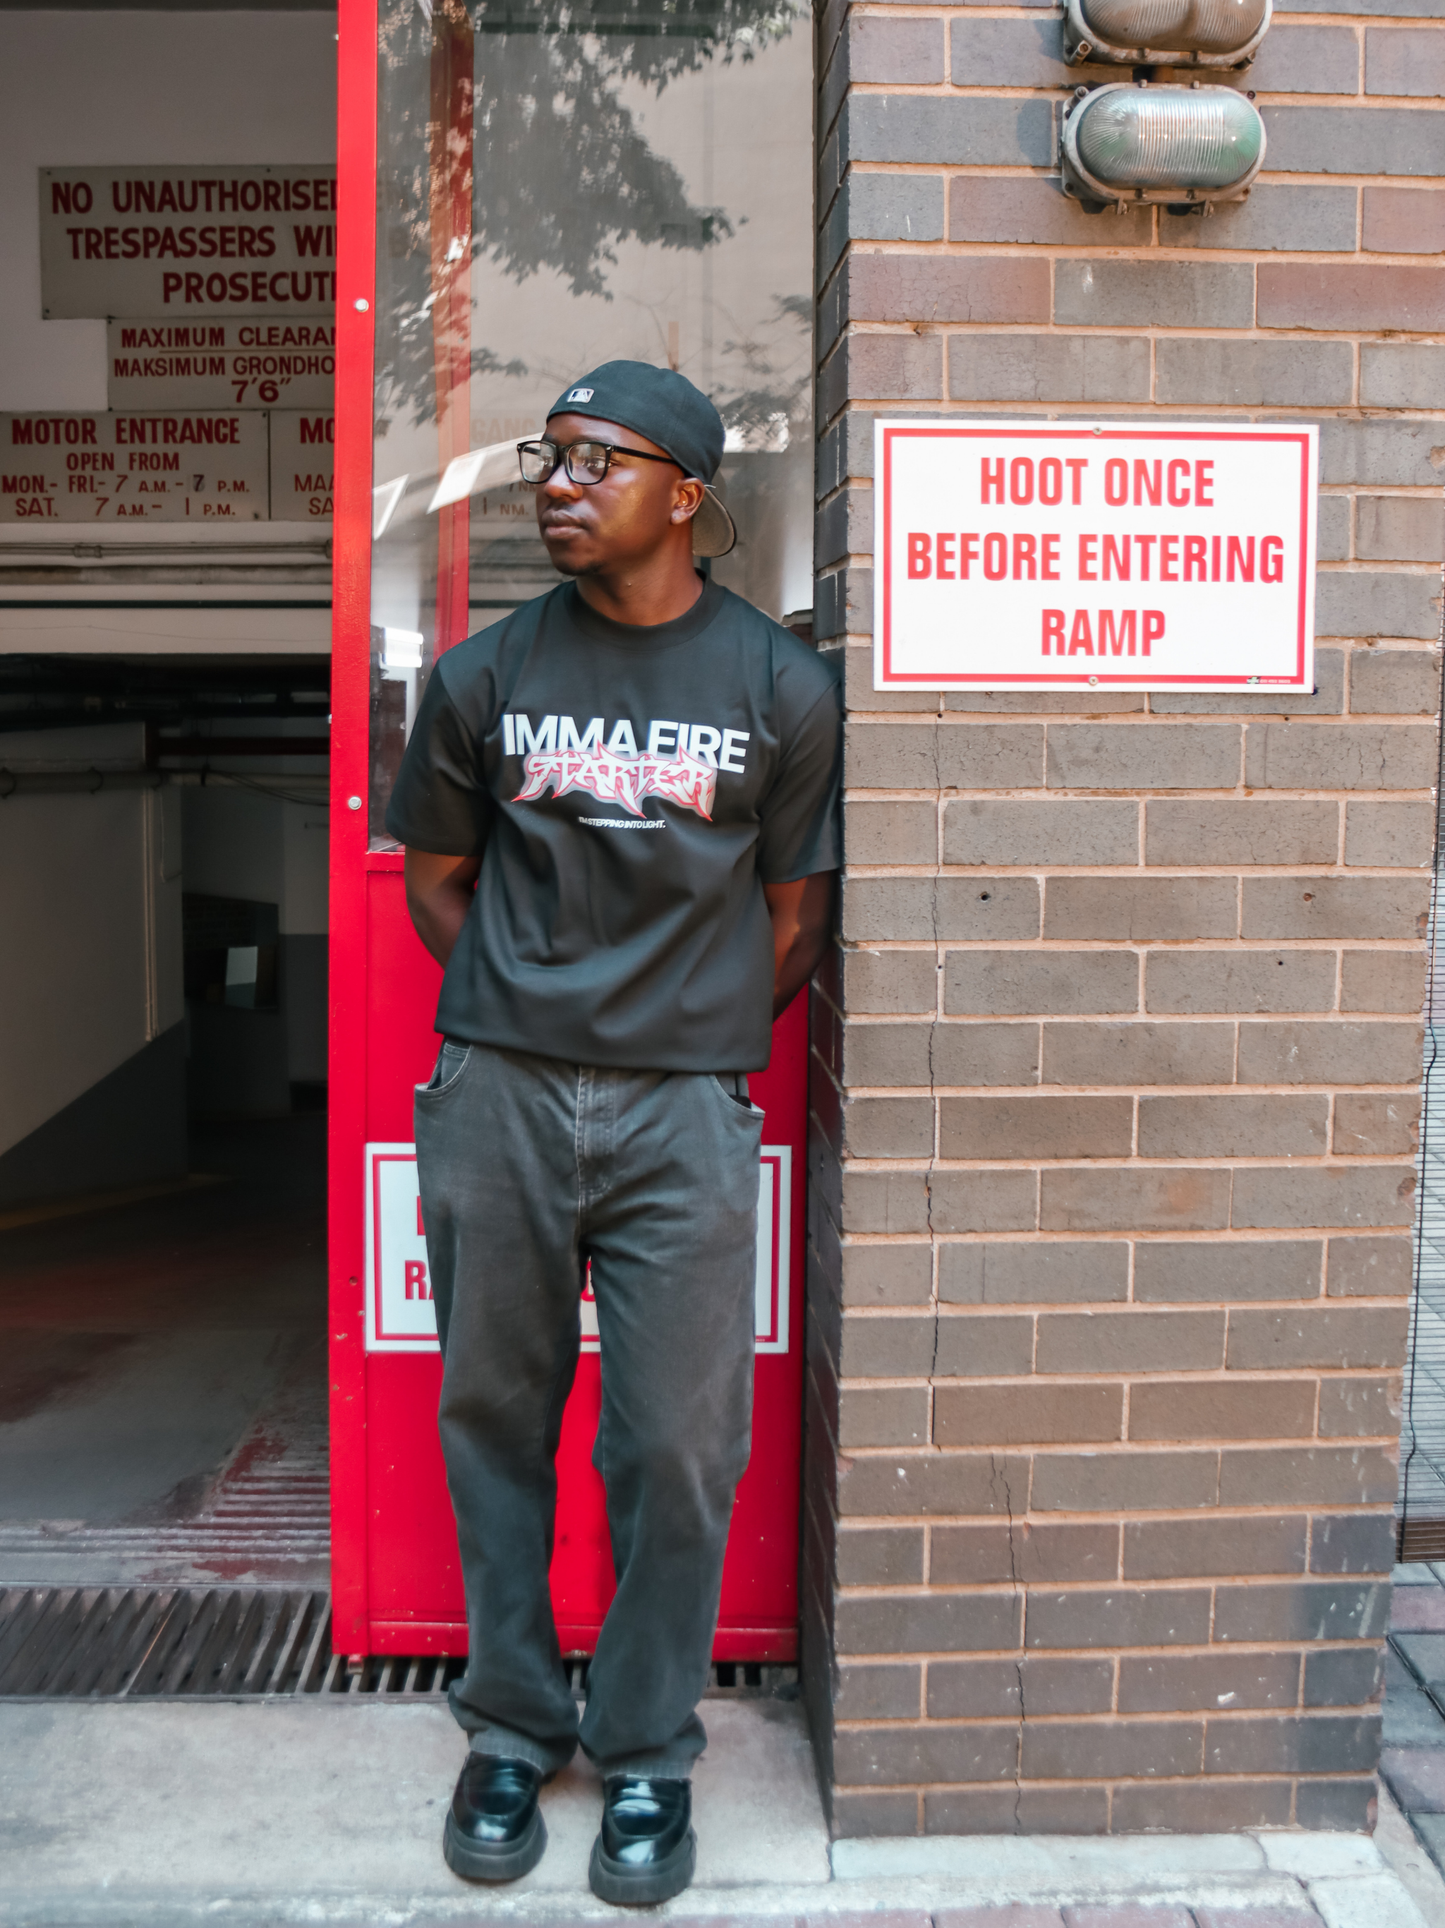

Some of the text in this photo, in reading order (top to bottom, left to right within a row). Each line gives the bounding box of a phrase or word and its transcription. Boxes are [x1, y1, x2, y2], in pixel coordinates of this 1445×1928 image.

[52, 182, 94, 214] NO
[66, 226, 276, 260] TRESPASSERS
[121, 327, 225, 348] MAXIMUM
[114, 356, 226, 377] MAKSIMUM
[12, 418, 240, 445] MOTOR ENTRANCE
[66, 452, 180, 471] OPEN FROM
[115, 474, 129, 493] 7
[193, 474, 205, 492] 7
[217, 480, 250, 493] P.M.
[980, 456, 1215, 507] HOOT ONCE
[16, 497, 58, 517] SAT.
[95, 497, 110, 516] 7
[203, 503, 236, 516] P.M.
[907, 531, 1285, 584] BEFORE ENTERING
[1041, 608, 1166, 657] RAMP
[502, 713, 751, 774] IMMA FIRE
[511, 739, 714, 822] STARTER
[588, 818, 625, 828] STEPPING
[623, 819, 643, 829] INTO
